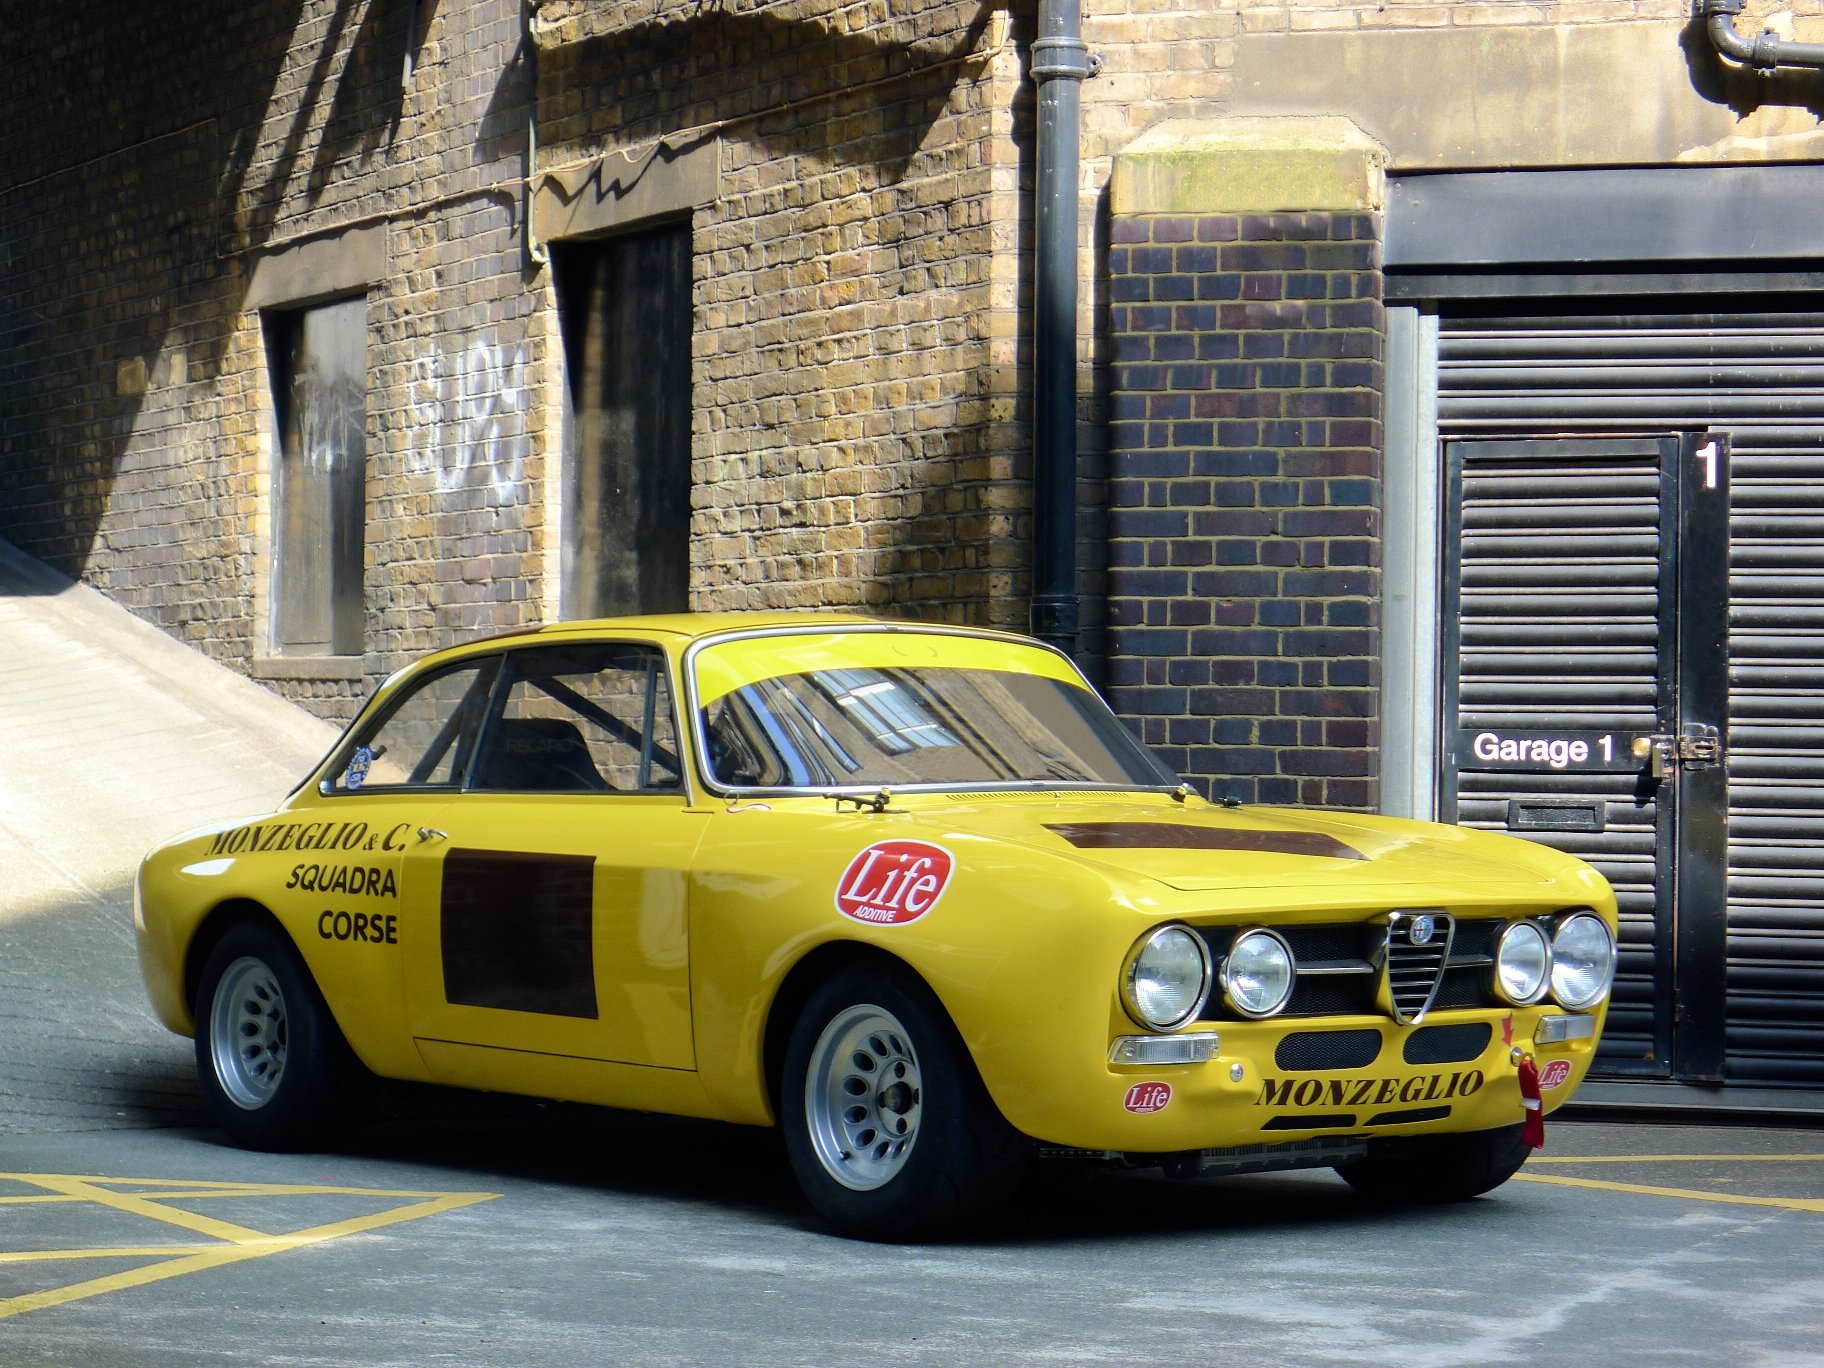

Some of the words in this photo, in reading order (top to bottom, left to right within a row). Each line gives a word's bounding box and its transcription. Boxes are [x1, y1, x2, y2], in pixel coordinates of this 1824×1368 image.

[1695, 441, 1716, 488] 1
[1474, 732, 1589, 768] Garage
[1599, 734, 1613, 762] 1
[204, 822, 369, 856] MONZEGLIO
[363, 832, 379, 851] &
[381, 822, 412, 852] C.
[285, 863, 397, 899] SQUADRA
[840, 849, 938, 912] Life
[317, 909, 398, 945] CORSE
[853, 905, 897, 922] ADDITIVE
[1252, 1069, 1485, 1107] MONZEGLIO
[1538, 1064, 1567, 1085] Life
[1126, 1086, 1168, 1108] Life
